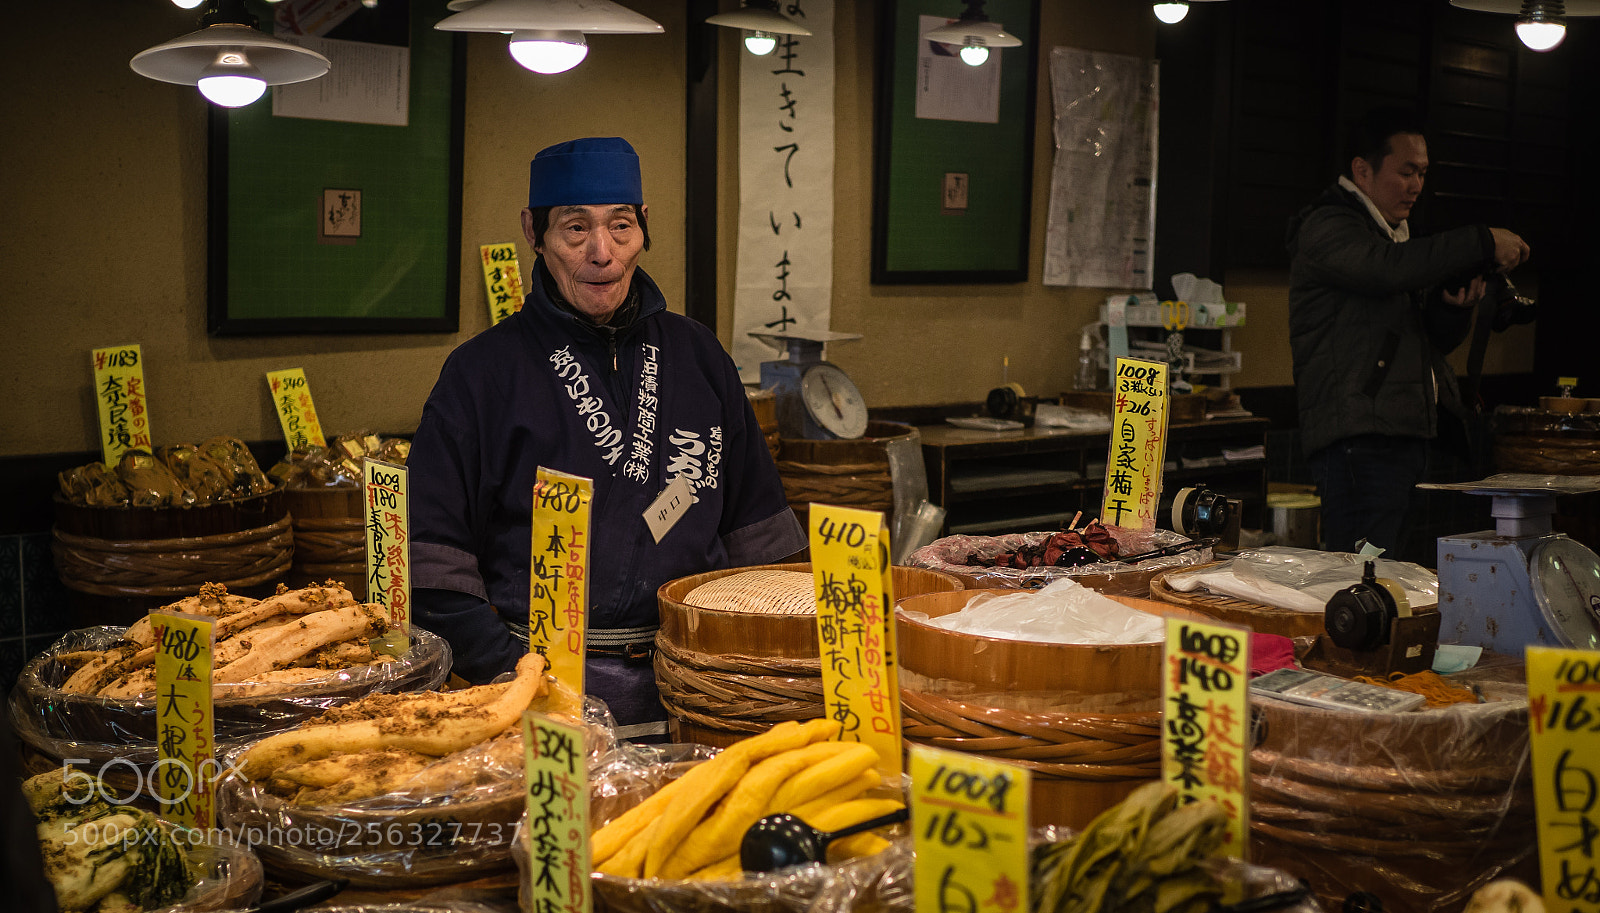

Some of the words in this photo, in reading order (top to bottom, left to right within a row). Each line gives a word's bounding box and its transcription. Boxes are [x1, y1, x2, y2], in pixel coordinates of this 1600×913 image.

[1107, 418, 1139, 527] 自家梅干
[563, 525, 584, 655] 上品な甘口
